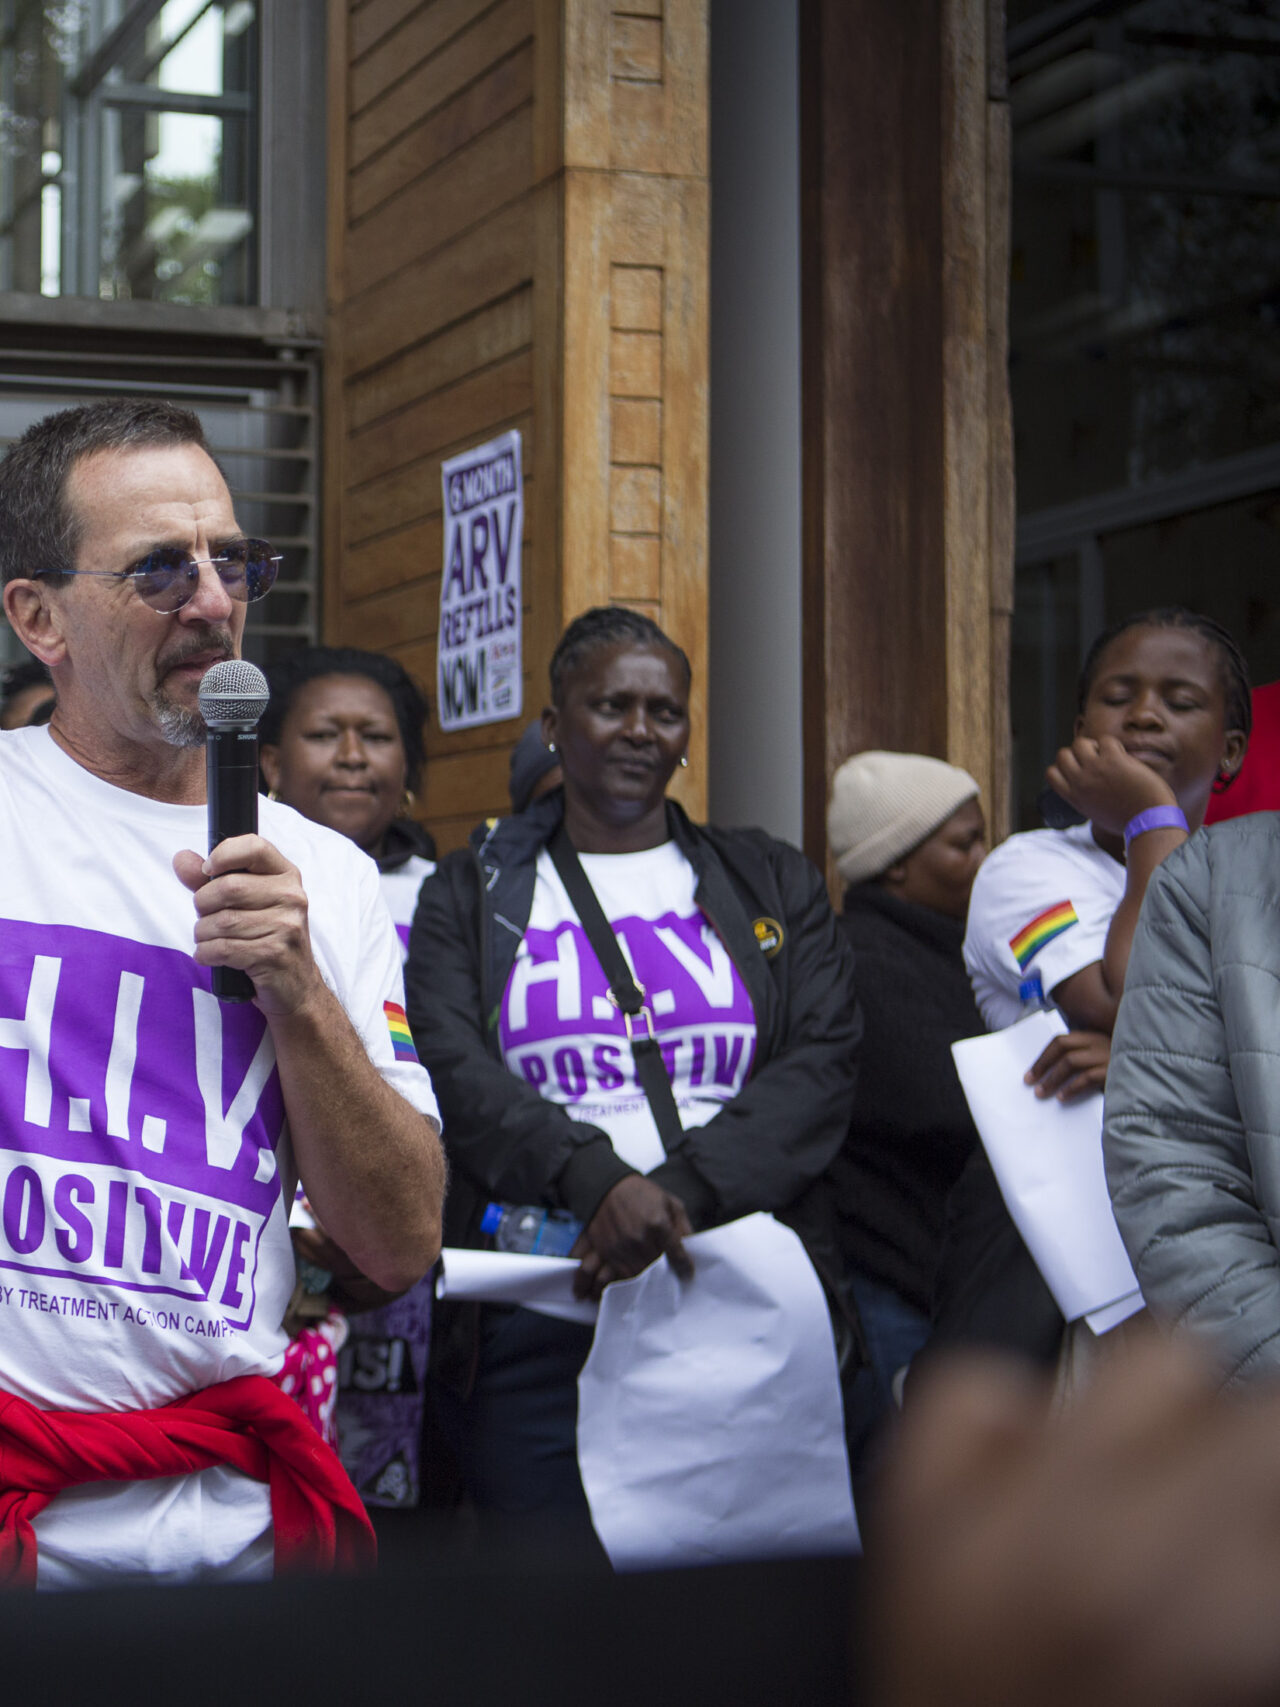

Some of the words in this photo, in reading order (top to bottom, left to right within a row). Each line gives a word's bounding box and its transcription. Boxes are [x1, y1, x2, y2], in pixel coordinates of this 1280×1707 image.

[463, 455, 514, 504] MONTH
[444, 502, 516, 600] ARV
[441, 585, 516, 650] REFILLS
[440, 650, 487, 722] NOW!
[19, 1289, 119, 1321] TREATMENT
